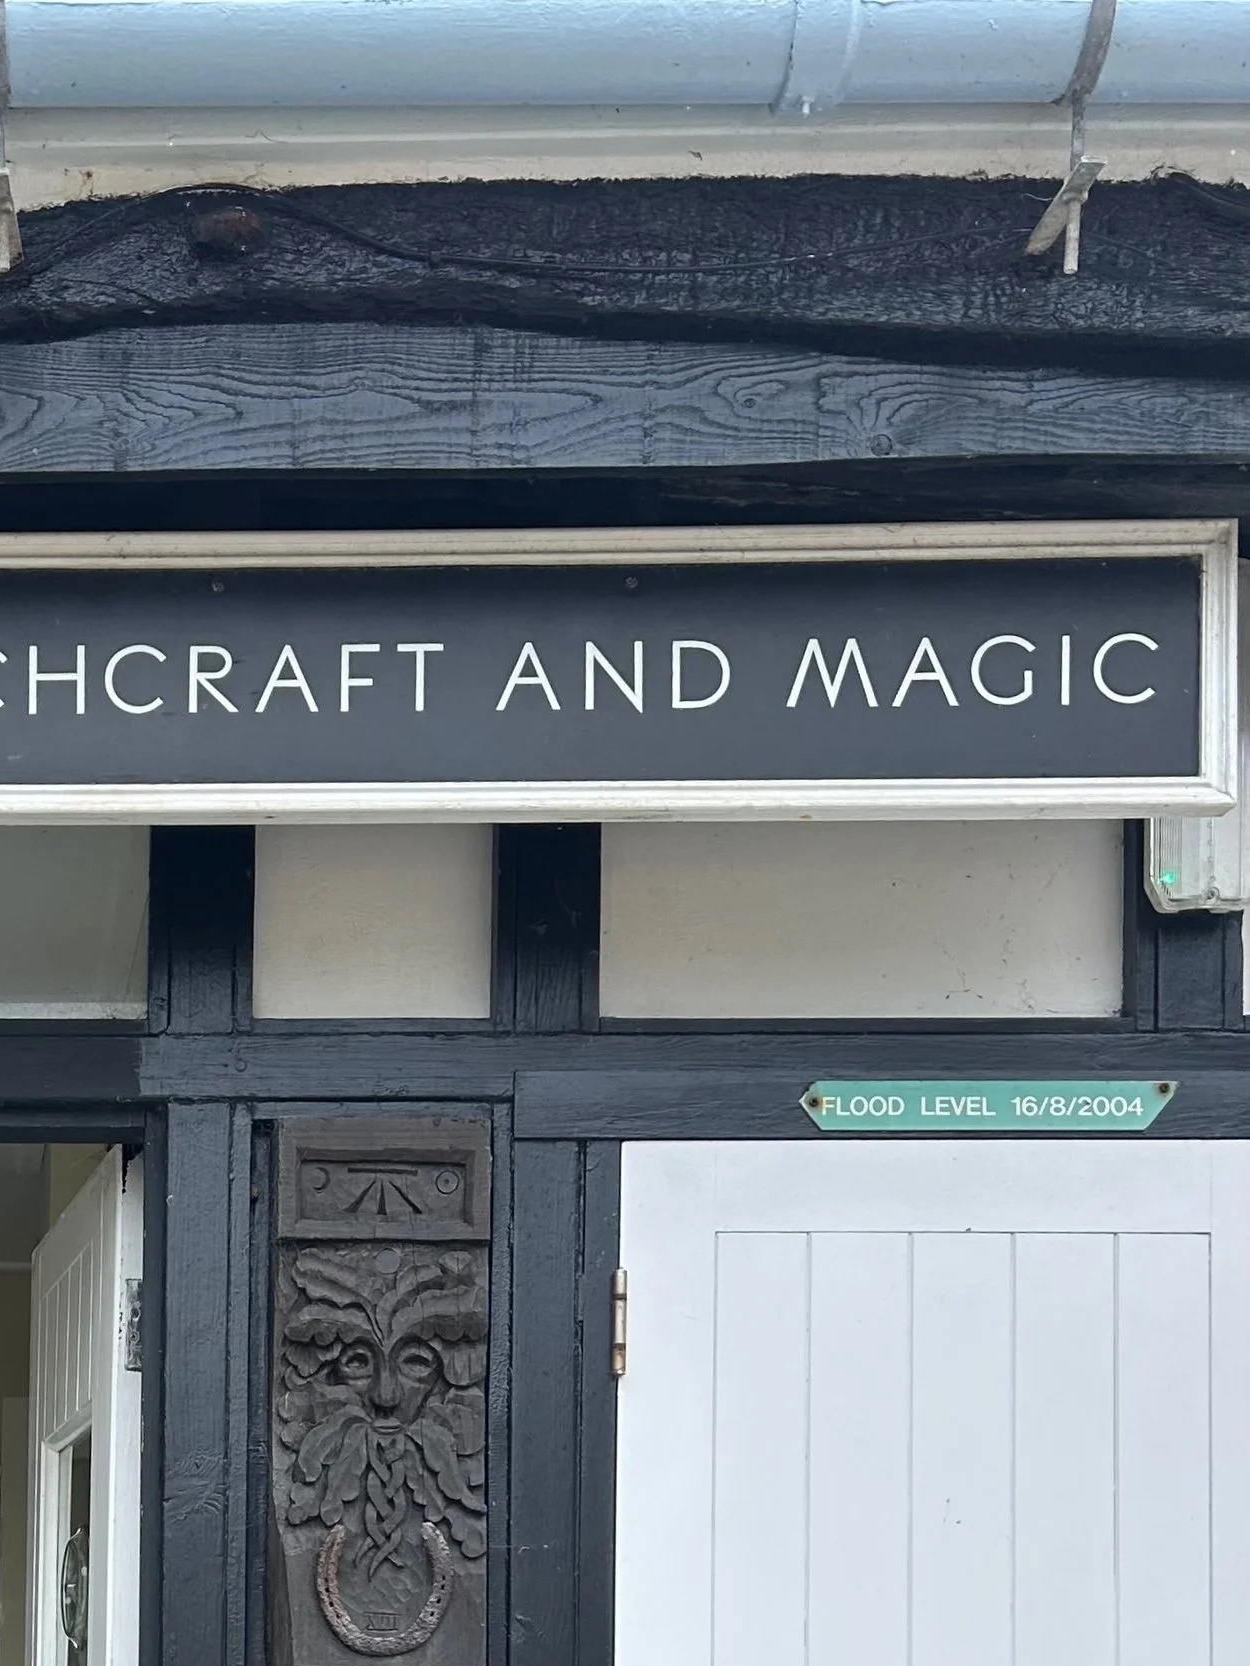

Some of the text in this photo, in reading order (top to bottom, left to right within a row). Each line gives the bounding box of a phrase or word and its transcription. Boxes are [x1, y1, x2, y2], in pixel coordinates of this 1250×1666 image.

[495, 640, 731, 713] AND
[786, 633, 1159, 708] MAGIC
[821, 1095, 1144, 1118] FLOOD LEVEL 16/8/2004
